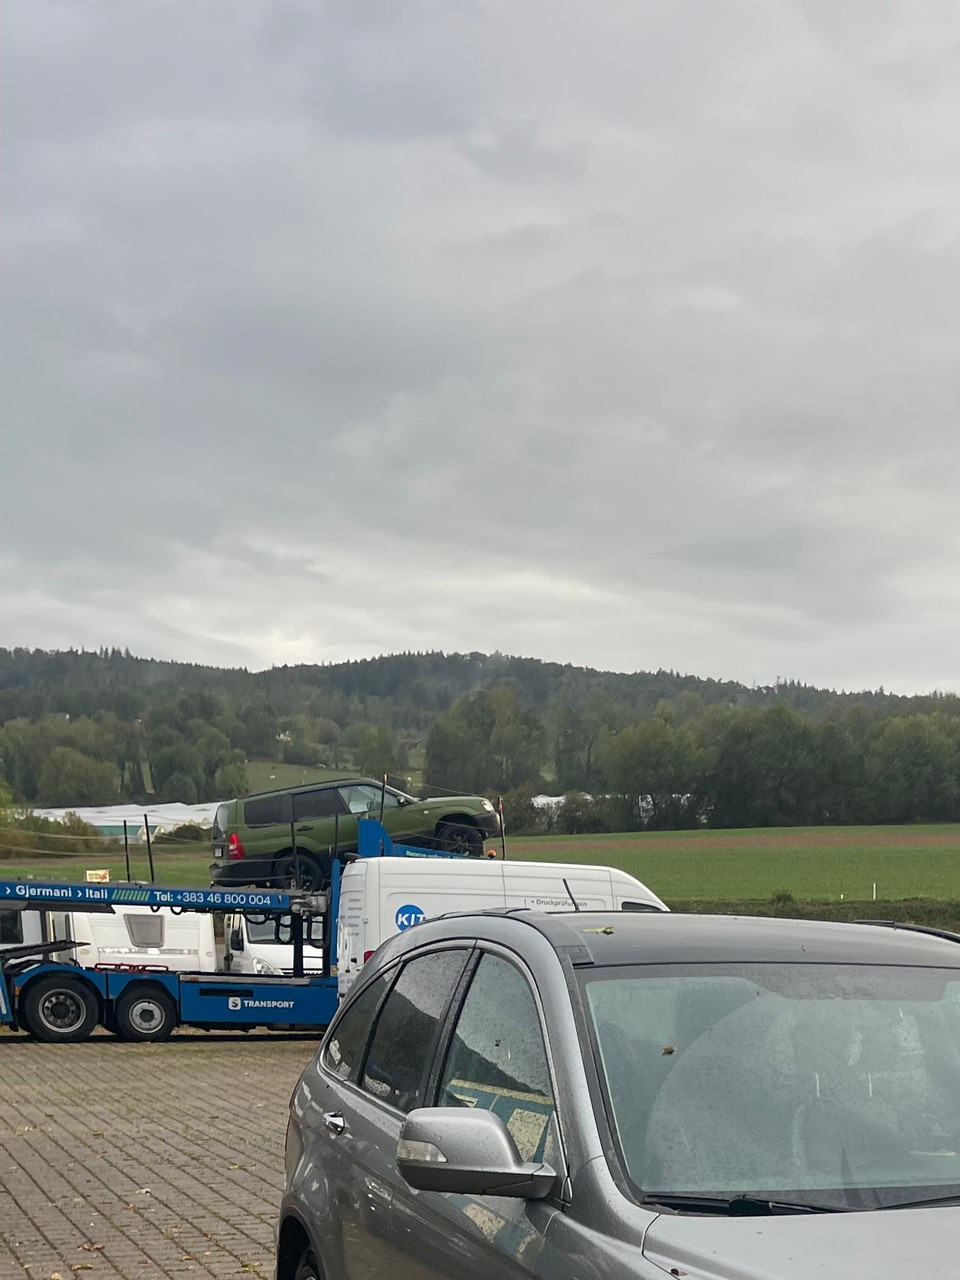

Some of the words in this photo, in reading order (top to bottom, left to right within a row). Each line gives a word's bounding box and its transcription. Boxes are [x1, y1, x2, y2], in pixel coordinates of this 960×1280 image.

[16, 885, 72, 898] Gjermani
[85, 888, 108, 899] Itali
[154, 891, 173, 902] Tel:
[176, 892, 204, 903] +383
[207, 893, 222, 903] 46
[224, 894, 246, 905] 800
[248, 895, 271, 905] 004
[536, 899, 588, 907] Druckprüfunen
[243, 1000, 294, 1009] TRANSPORT
